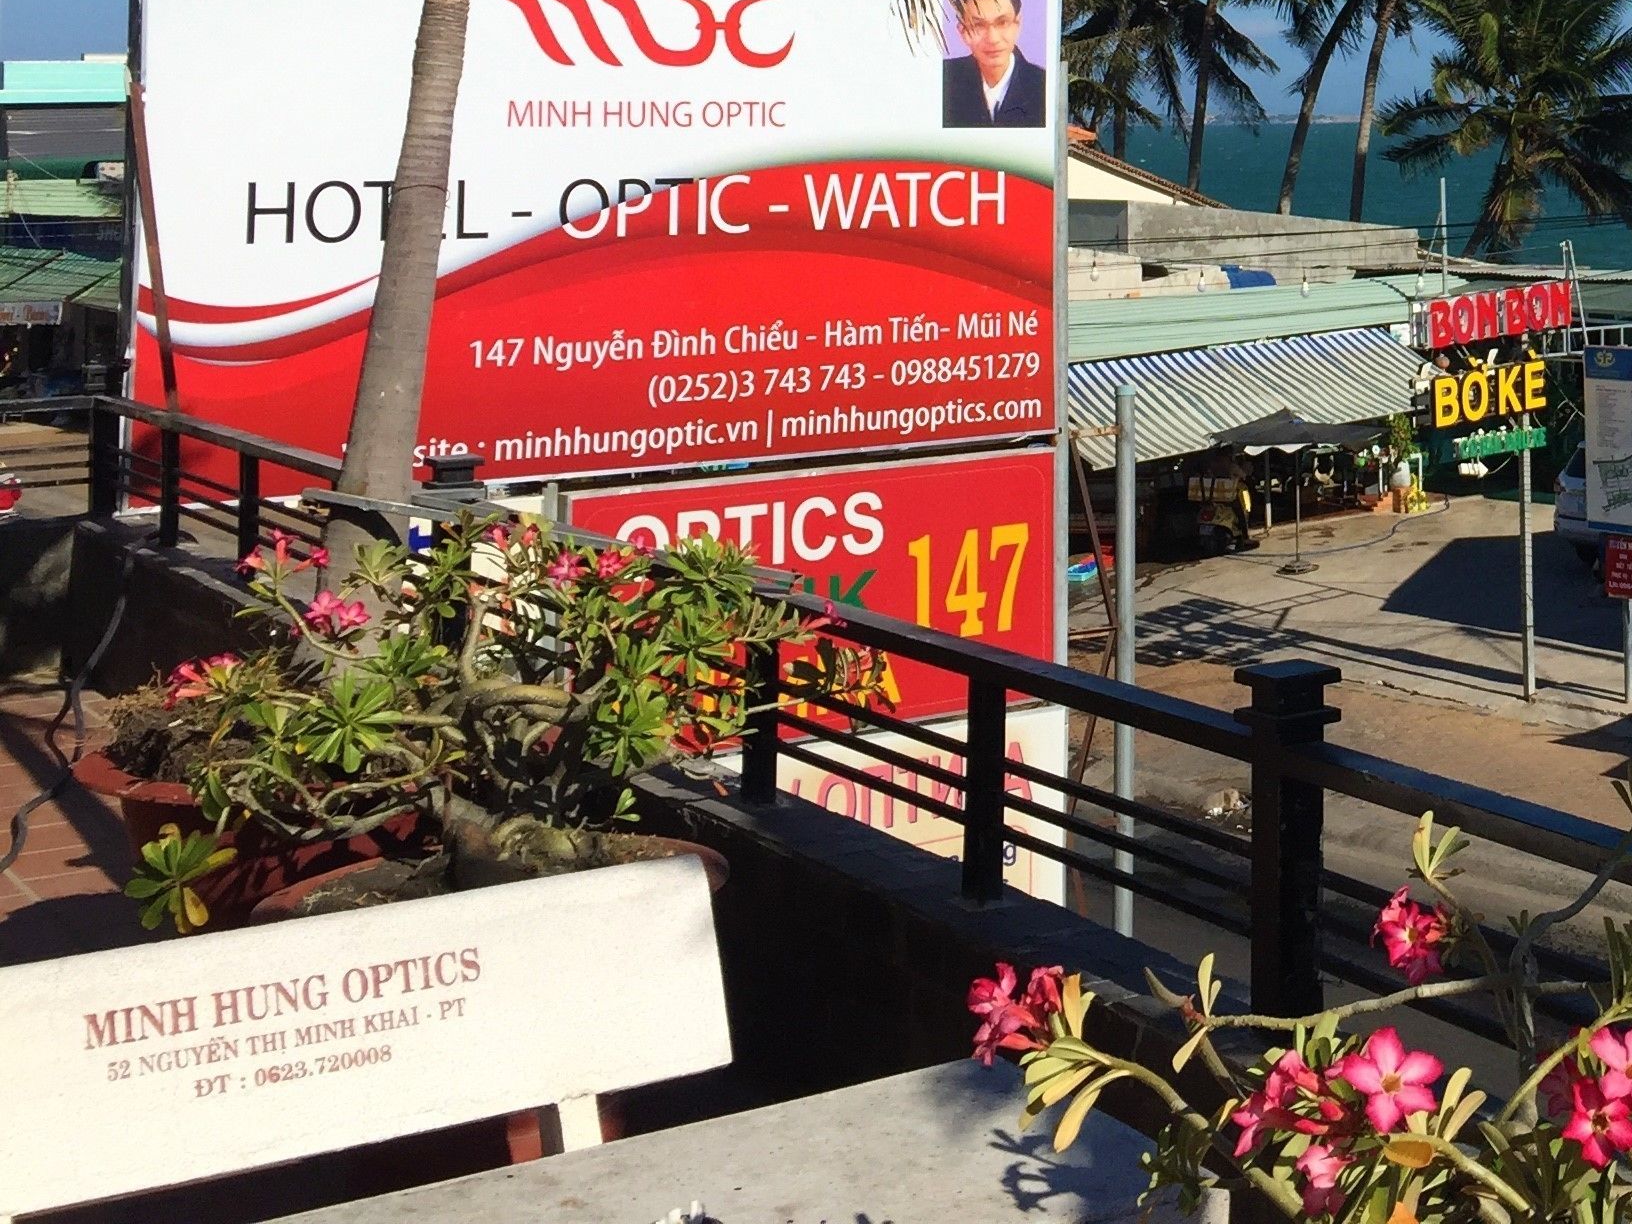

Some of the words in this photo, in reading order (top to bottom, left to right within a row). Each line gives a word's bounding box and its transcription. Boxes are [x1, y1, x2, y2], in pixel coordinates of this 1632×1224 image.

[507, 100, 592, 128] MINH
[602, 100, 692, 128] HUNG
[702, 100, 787, 128] OPTIC
[245, 180, 489, 244] HOTL
[559, 174, 752, 239] OPTIC
[803, 171, 1007, 231] WATCH
[469, 337, 525, 369] 147
[532, 328, 644, 372] Nguyễn
[651, 328, 717, 359] Đình
[724, 319, 798, 355] Chiểu
[824, 320, 883, 348] Hàm
[957, 311, 1001, 339] Mũi
[1008, 309, 1039, 336] Né
[1429, 290, 1499, 349] BON
[1504, 281, 1572, 336] BON
[648, 370, 755, 408] (0252)3
[763, 368, 811, 395] 743
[819, 363, 866, 391] 743
[890, 351, 1041, 386] 0988451279
[1498, 349, 1547, 415] KÈ
[494, 418, 758, 461] minhhungoptic.vn
[781, 398, 1042, 438] minhhungoptics.com
[908, 522, 1030, 638] 147
[83, 996, 199, 1050] MINH
[211, 974, 329, 1029] HUNG
[342, 947, 482, 1003] OPTICS
[106, 1059, 131, 1082] 52
[139, 1035, 239, 1077] NGUYỄN
[246, 1030, 286, 1056] THỊ
[294, 1017, 356, 1048] MINH
[363, 1005, 421, 1035] KHAI
[438, 997, 467, 1021] PT
[254, 1044, 393, 1088] 0623.720008
